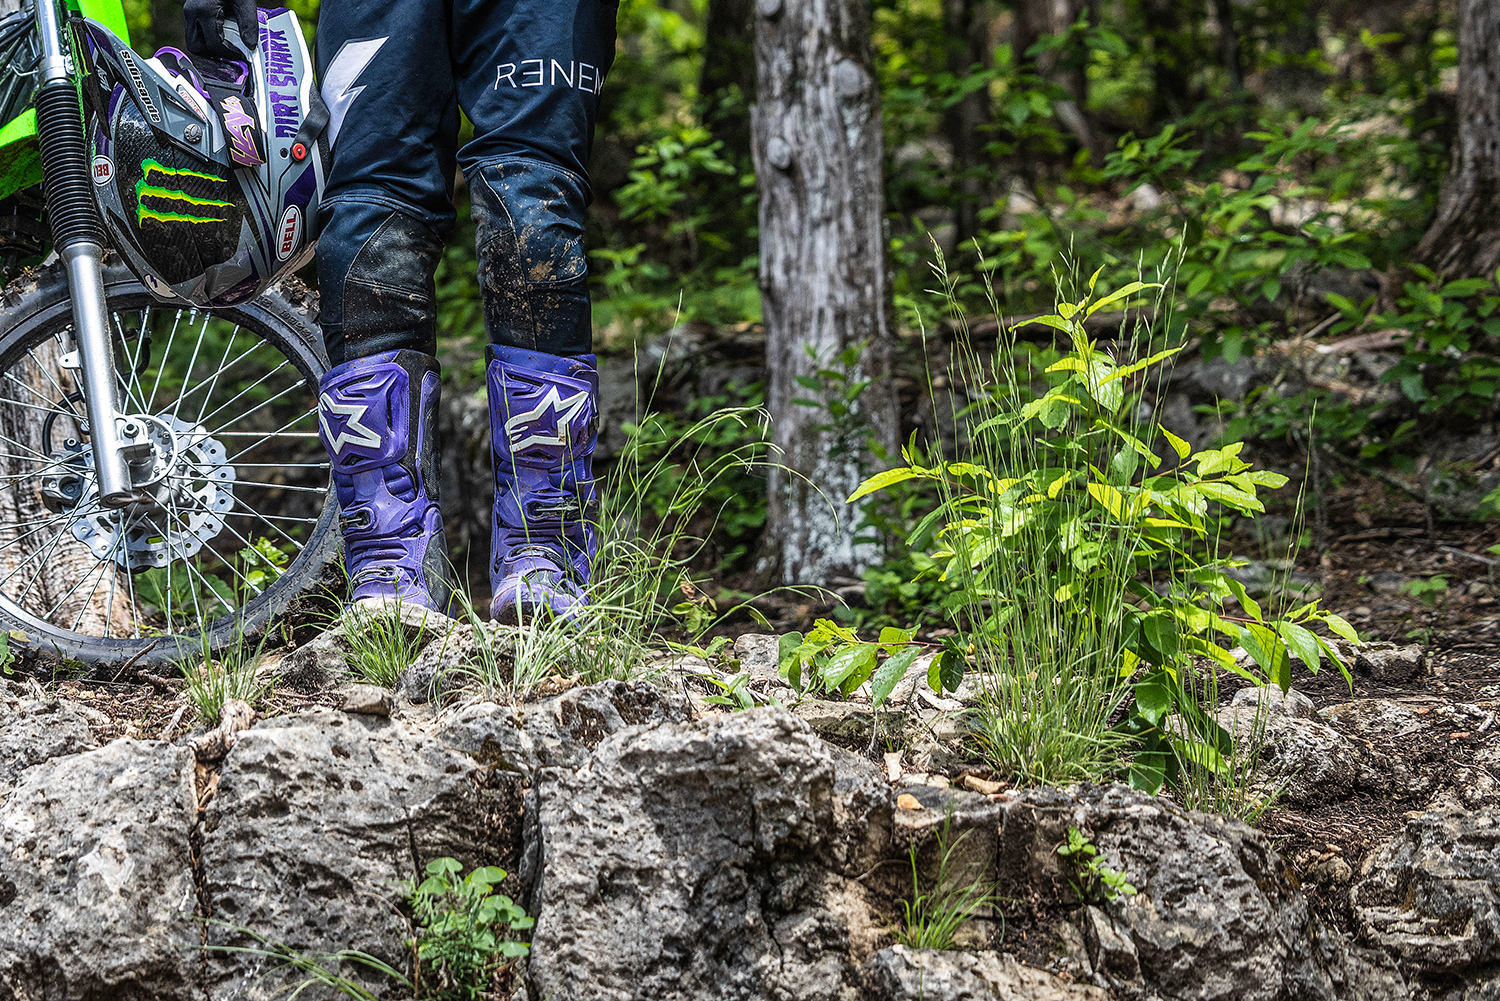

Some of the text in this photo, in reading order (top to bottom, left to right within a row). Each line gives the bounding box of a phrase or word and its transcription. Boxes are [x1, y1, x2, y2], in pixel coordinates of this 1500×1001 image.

[258, 27, 299, 139] DIRT SHARK
[280, 212, 297, 254] BELL
